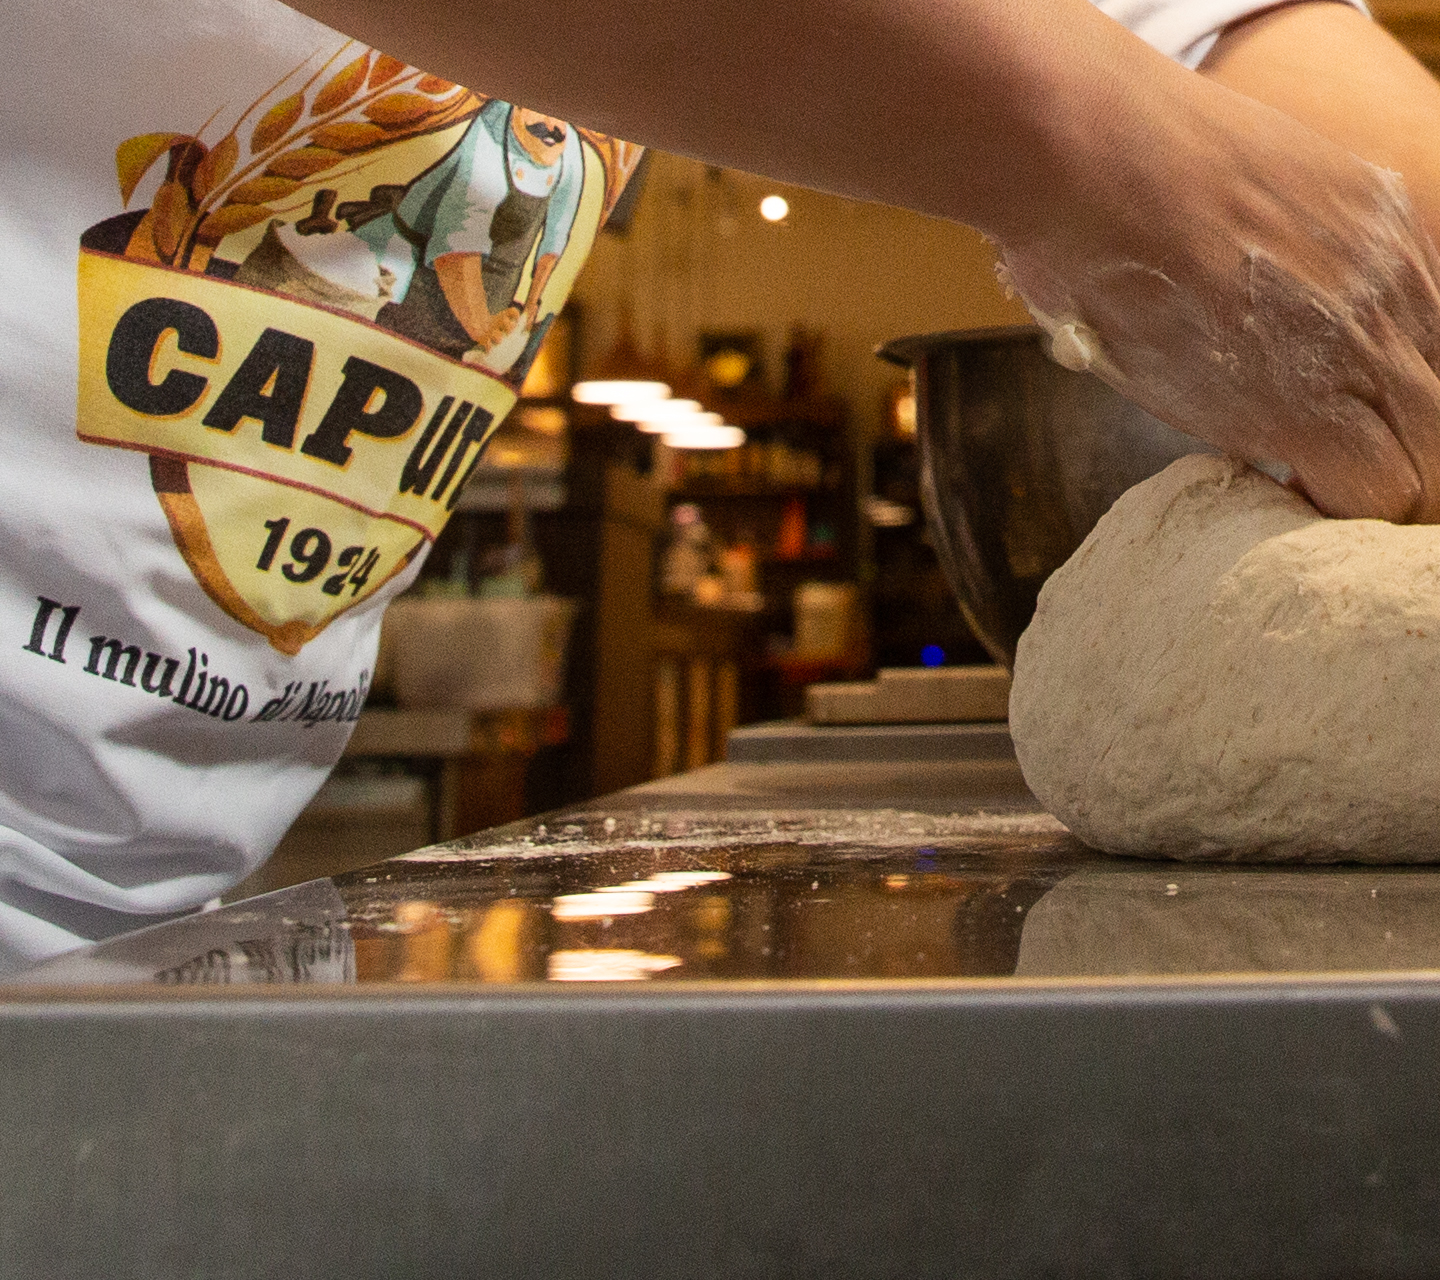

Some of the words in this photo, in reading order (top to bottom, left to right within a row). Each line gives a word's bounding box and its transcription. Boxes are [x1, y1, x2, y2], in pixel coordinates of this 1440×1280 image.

[256, 517, 381, 597] 1924
[22, 596, 82, 664] Il
[82, 634, 251, 722] mulino
